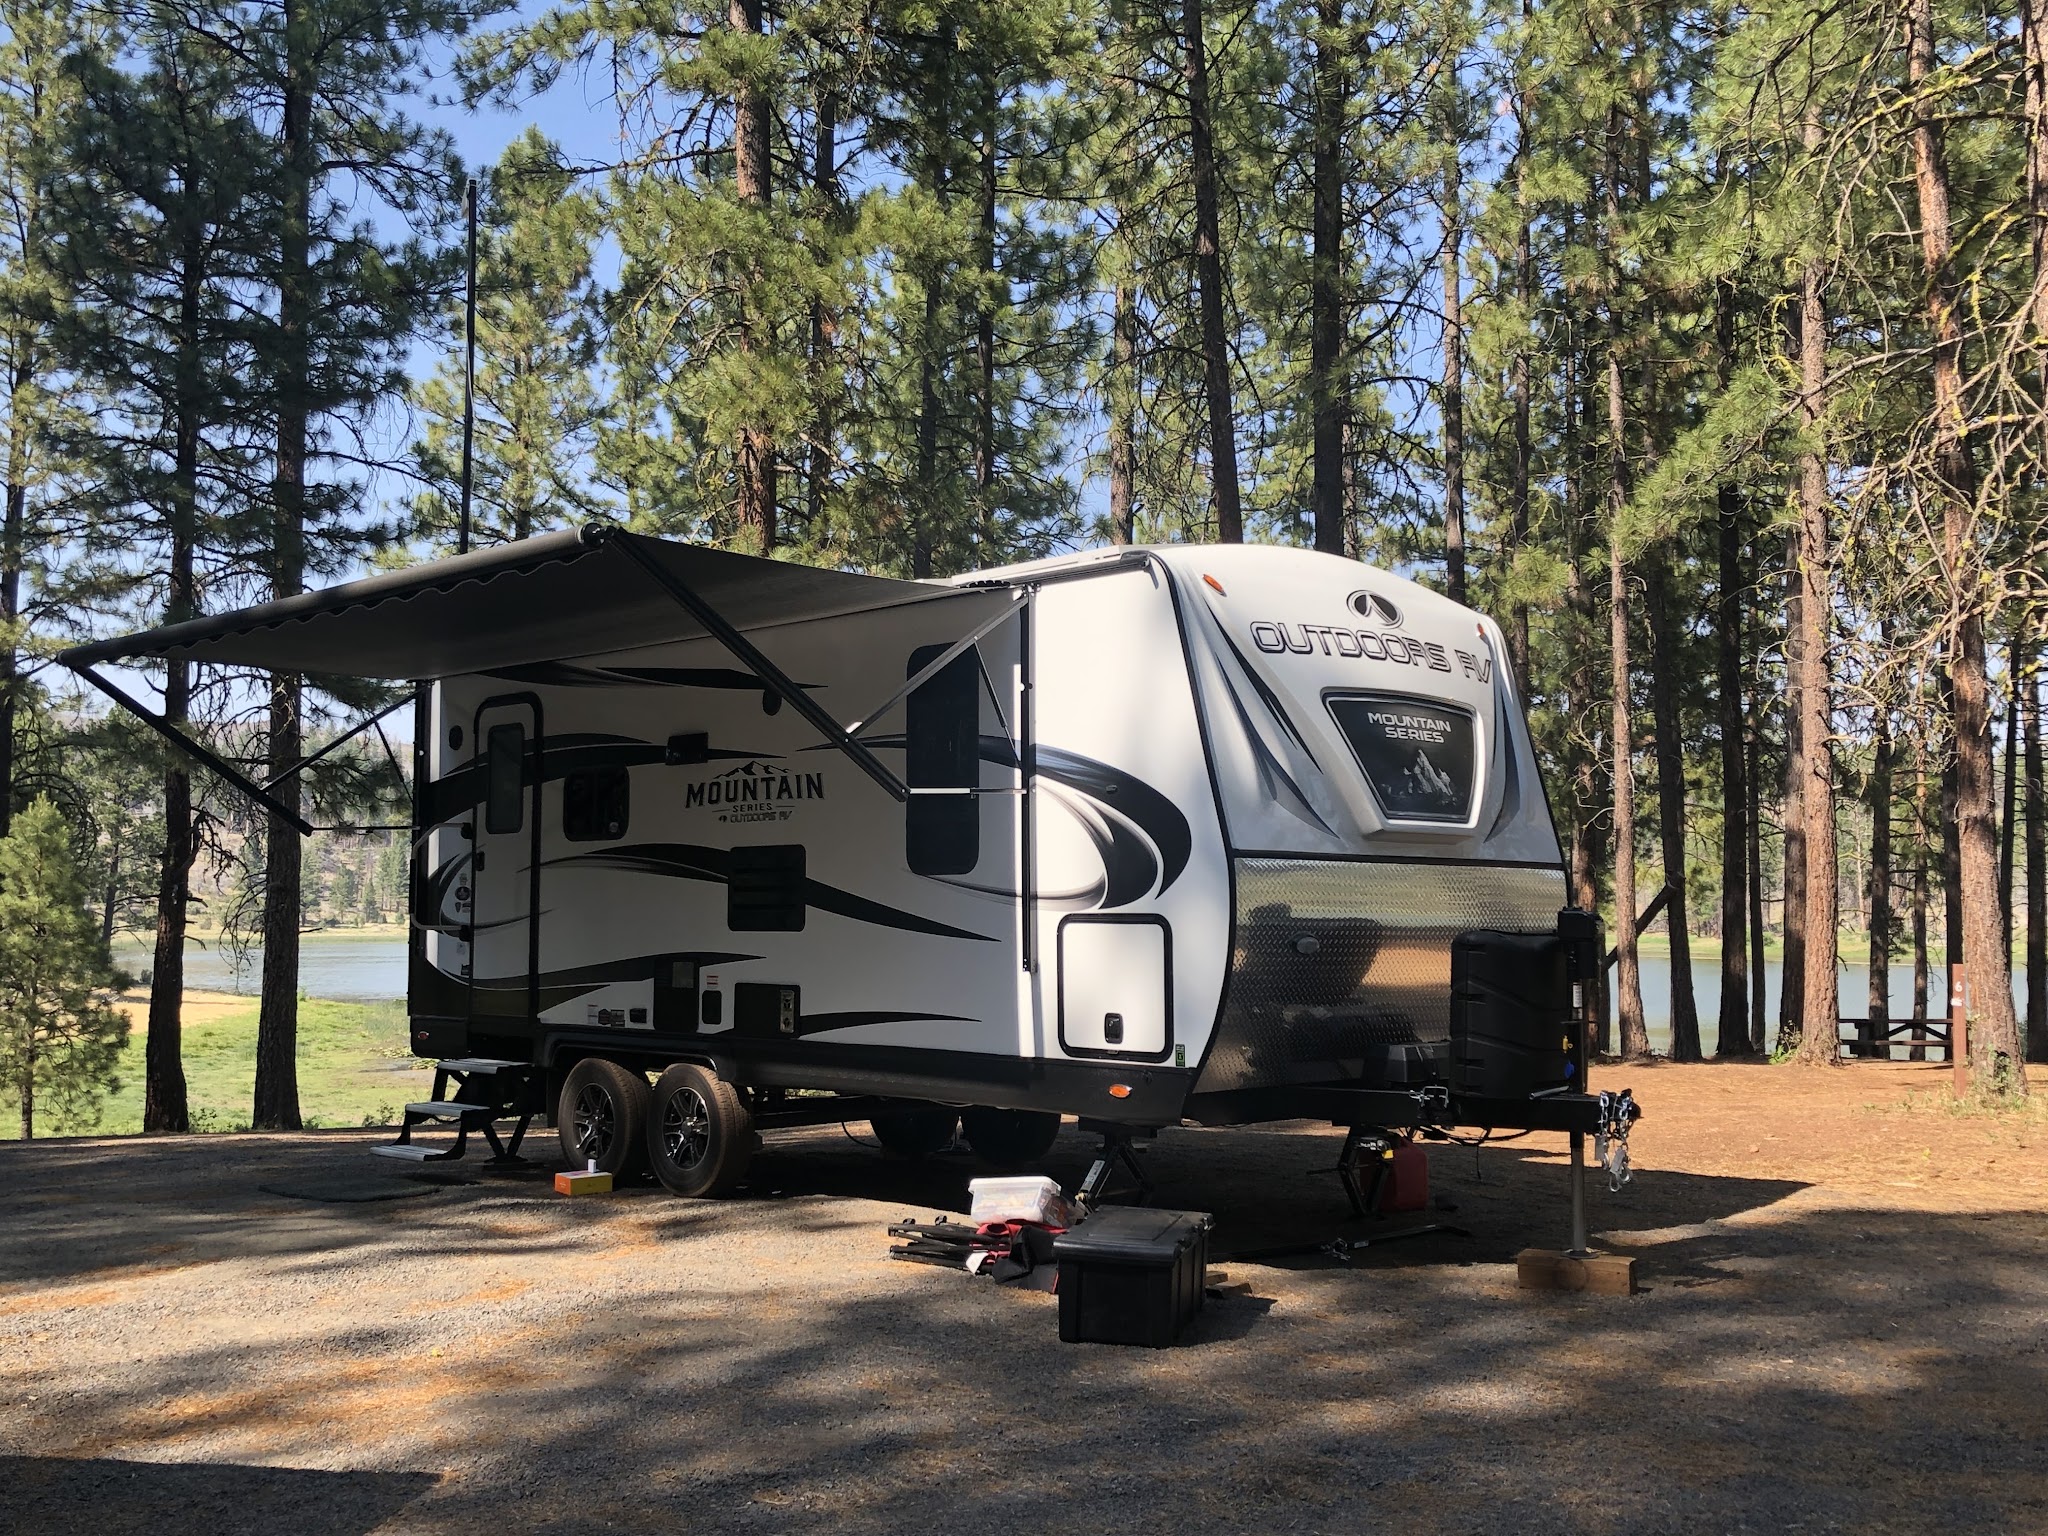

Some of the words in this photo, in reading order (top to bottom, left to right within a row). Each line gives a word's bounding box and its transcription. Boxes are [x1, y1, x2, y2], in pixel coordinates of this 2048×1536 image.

[1250, 621, 1451, 673] OUTDOORS
[1455, 649, 1491, 683] RV
[1367, 712, 1452, 732] MOUNTAIN
[1385, 726, 1445, 743] SERIES
[685, 773, 824, 808] MOUNTAIN
[732, 802, 773, 813] SERIES
[730, 811, 776, 823] OUTDOORS
[779, 810, 793, 821] RV
[1955, 981, 1963, 992] 6
